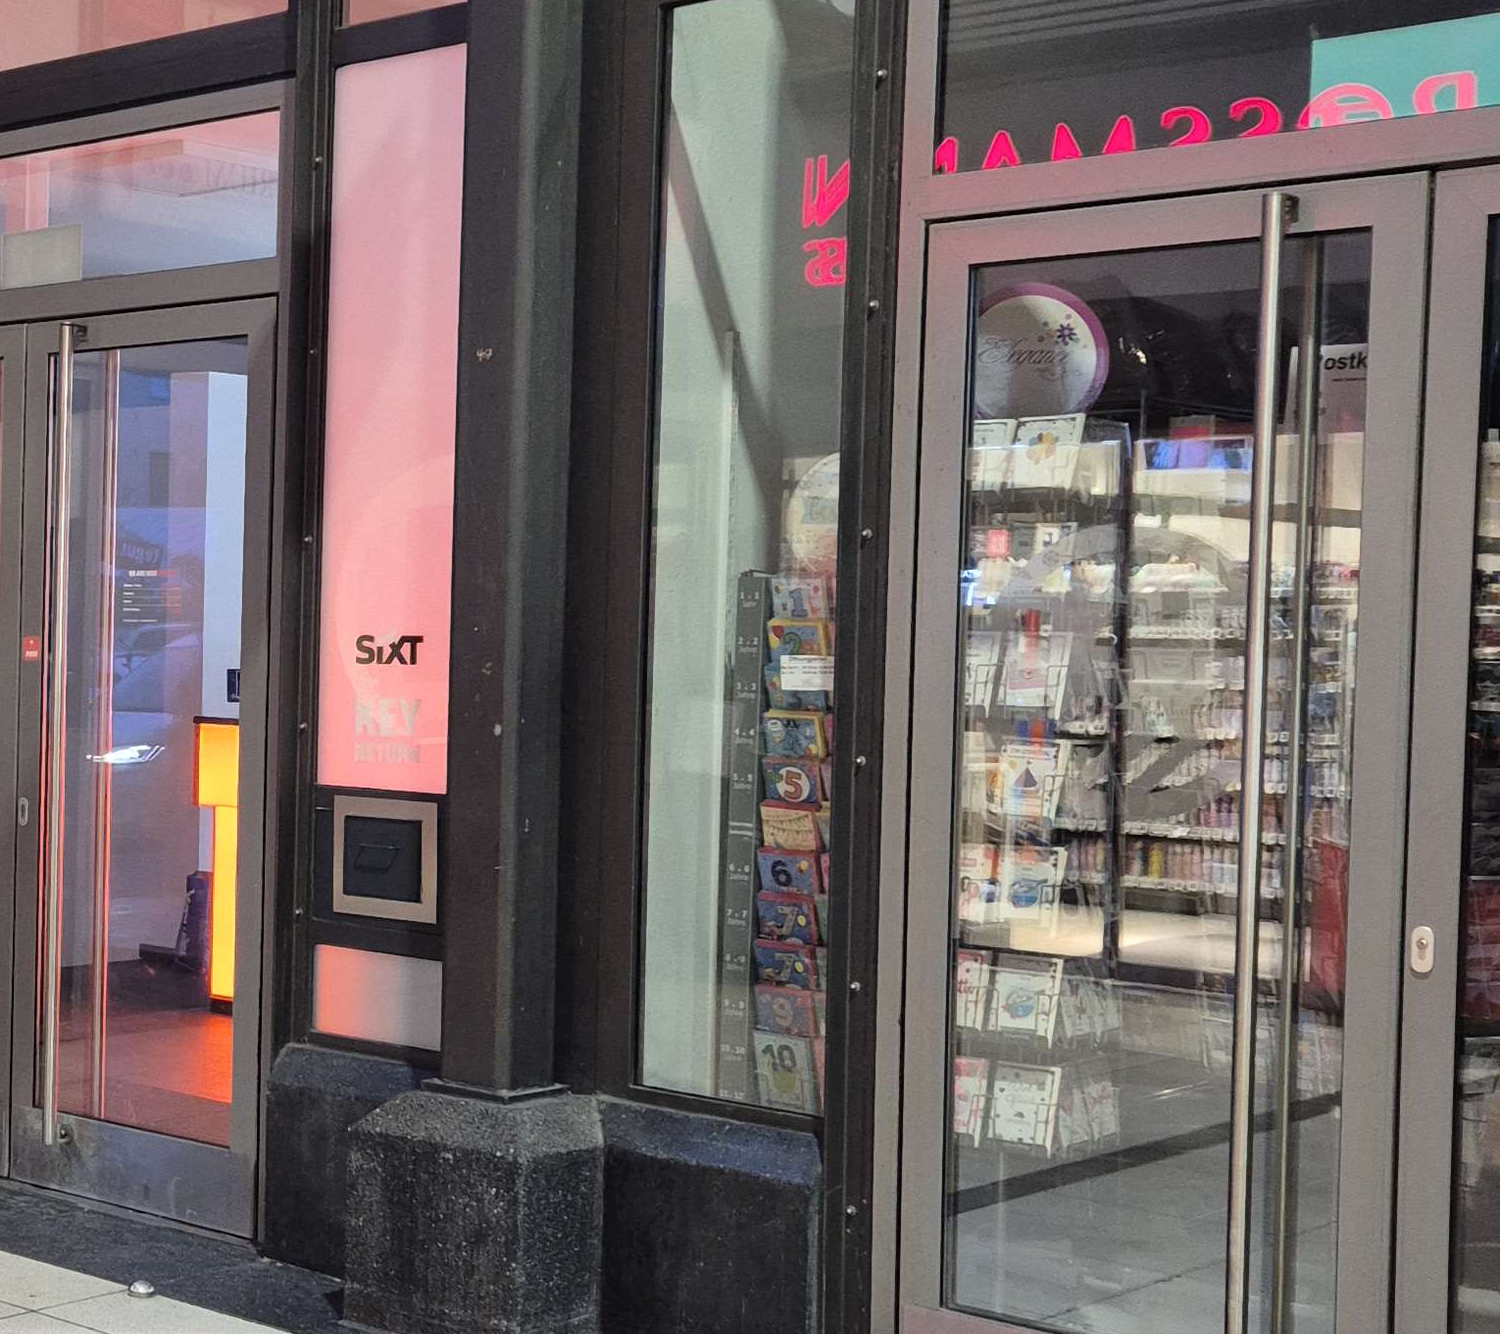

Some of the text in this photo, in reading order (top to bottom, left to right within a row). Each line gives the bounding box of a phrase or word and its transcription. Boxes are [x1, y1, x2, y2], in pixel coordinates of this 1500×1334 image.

[354, 698, 422, 738] KEY
[783, 769, 808, 800] 5
[770, 859, 793, 888] 6
[761, 1042, 797, 1072] 10
